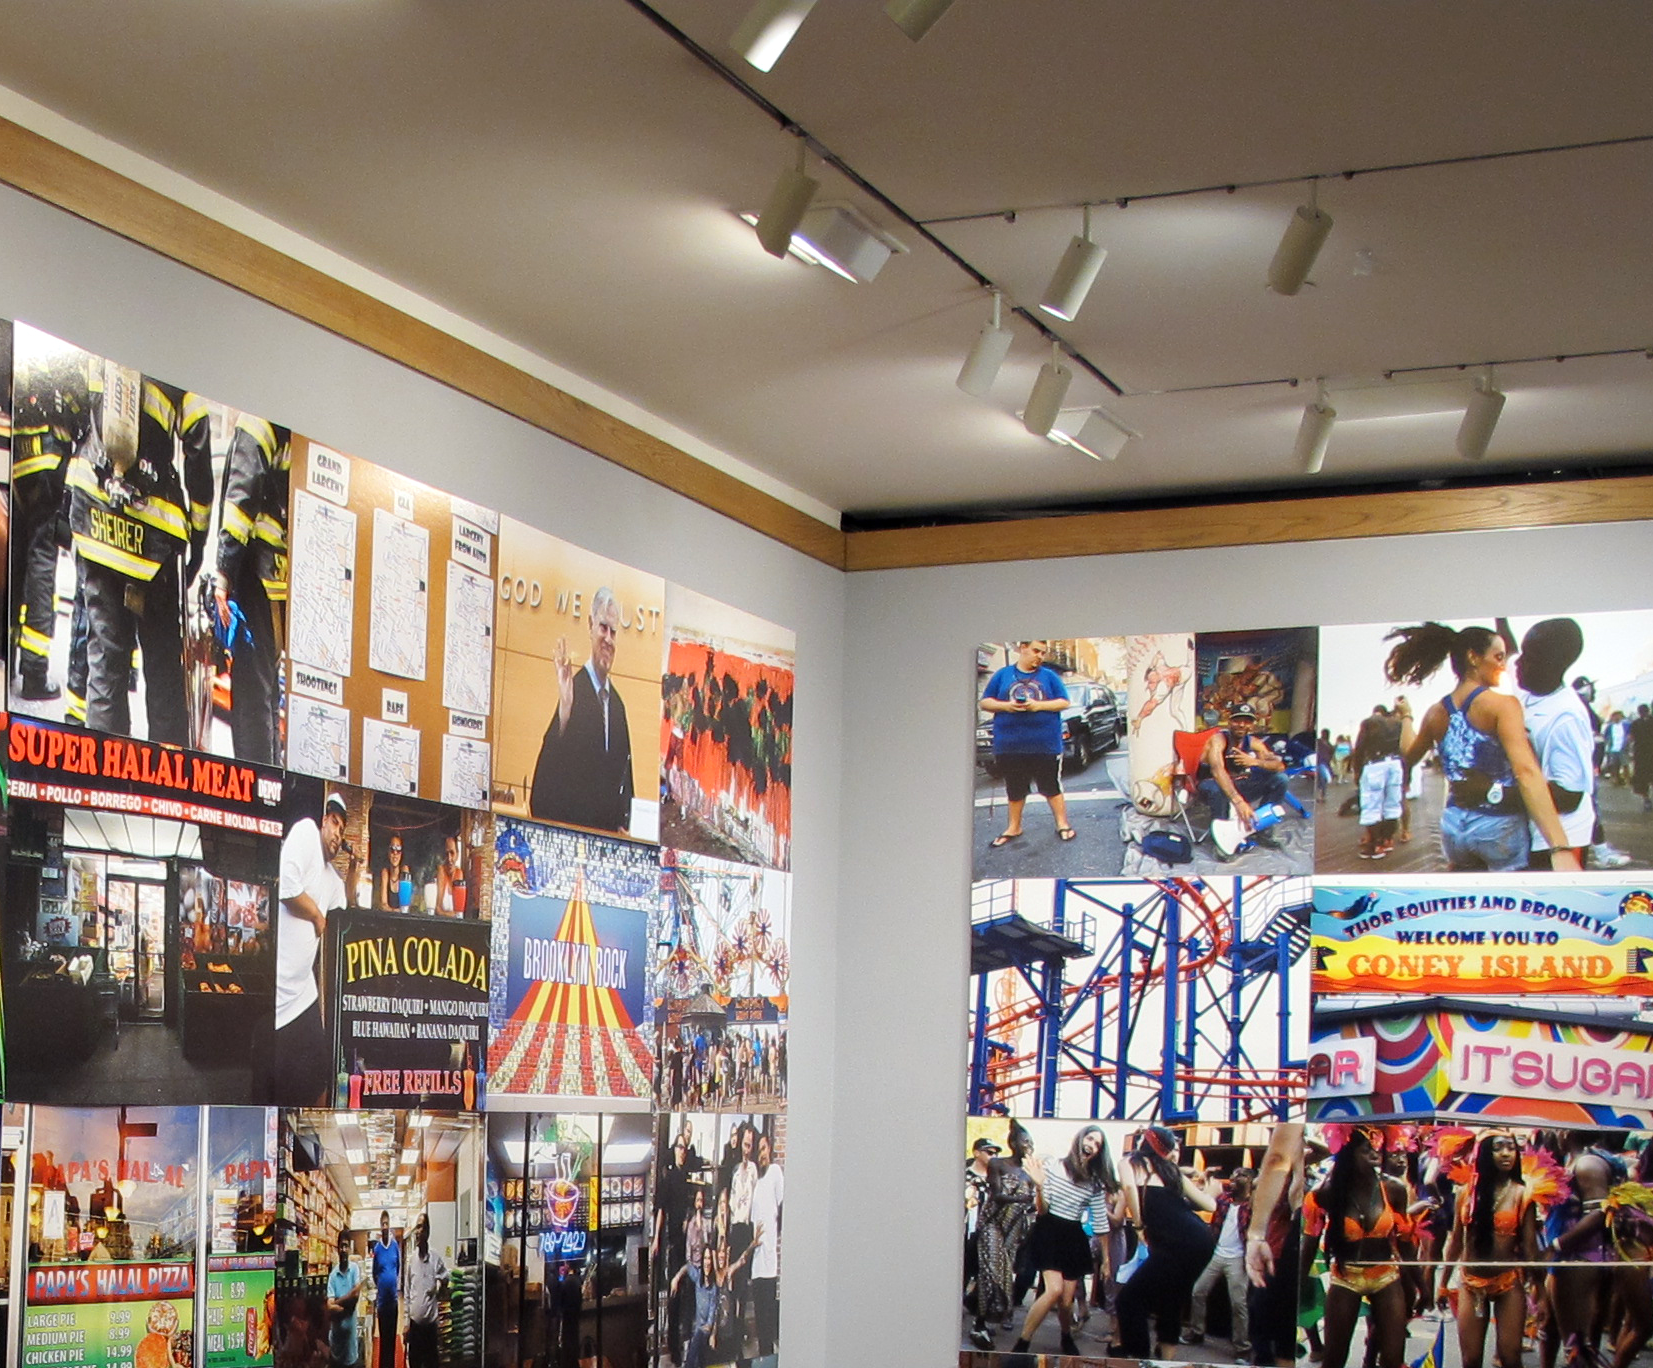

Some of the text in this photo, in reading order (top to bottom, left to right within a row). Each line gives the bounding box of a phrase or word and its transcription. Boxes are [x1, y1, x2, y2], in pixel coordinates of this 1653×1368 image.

[90, 507, 145, 555] SHEIRER
[499, 573, 660, 634] GOD WE UST
[9, 722, 255, 802] SUPER HALAL MEAT
[257, 778, 282, 803] DEPOT
[47, 785, 82, 805] POLLO
[90, 790, 141, 811] BORREGO
[151, 798, 183, 818] CHIVO
[190, 804, 223, 825] CARNE
[224, 813, 257, 832] MOLIDA
[1343, 895, 1619, 941] THOR EQUITIES AND BROOKLYN
[1397, 930, 1559, 947] WELCOME YOU TO
[345, 936, 488, 993] PINA COLADA
[523, 936, 628, 990] BROOKLYN ROCK
[1347, 954, 1614, 980] CONEY ISLAND
[429, 998, 458, 1016] MANGO
[352, 1020, 371, 1038] BLUE
[416, 1023, 447, 1040] BANANA
[363, 1070, 462, 1096] FREE REFILLS
[35, 1266, 189, 1298] PAPA'S HALAL PIZZA
[208, 1281, 224, 1300] FULL
[27, 1310, 132, 1328] LARGE PIE 9.99
[26, 1327, 130, 1347] MEDIUM PIE 8.99
[207, 1333, 225, 1353] MEAL
[26, 1345, 132, 1366] CHICKEN PIE 14.99
